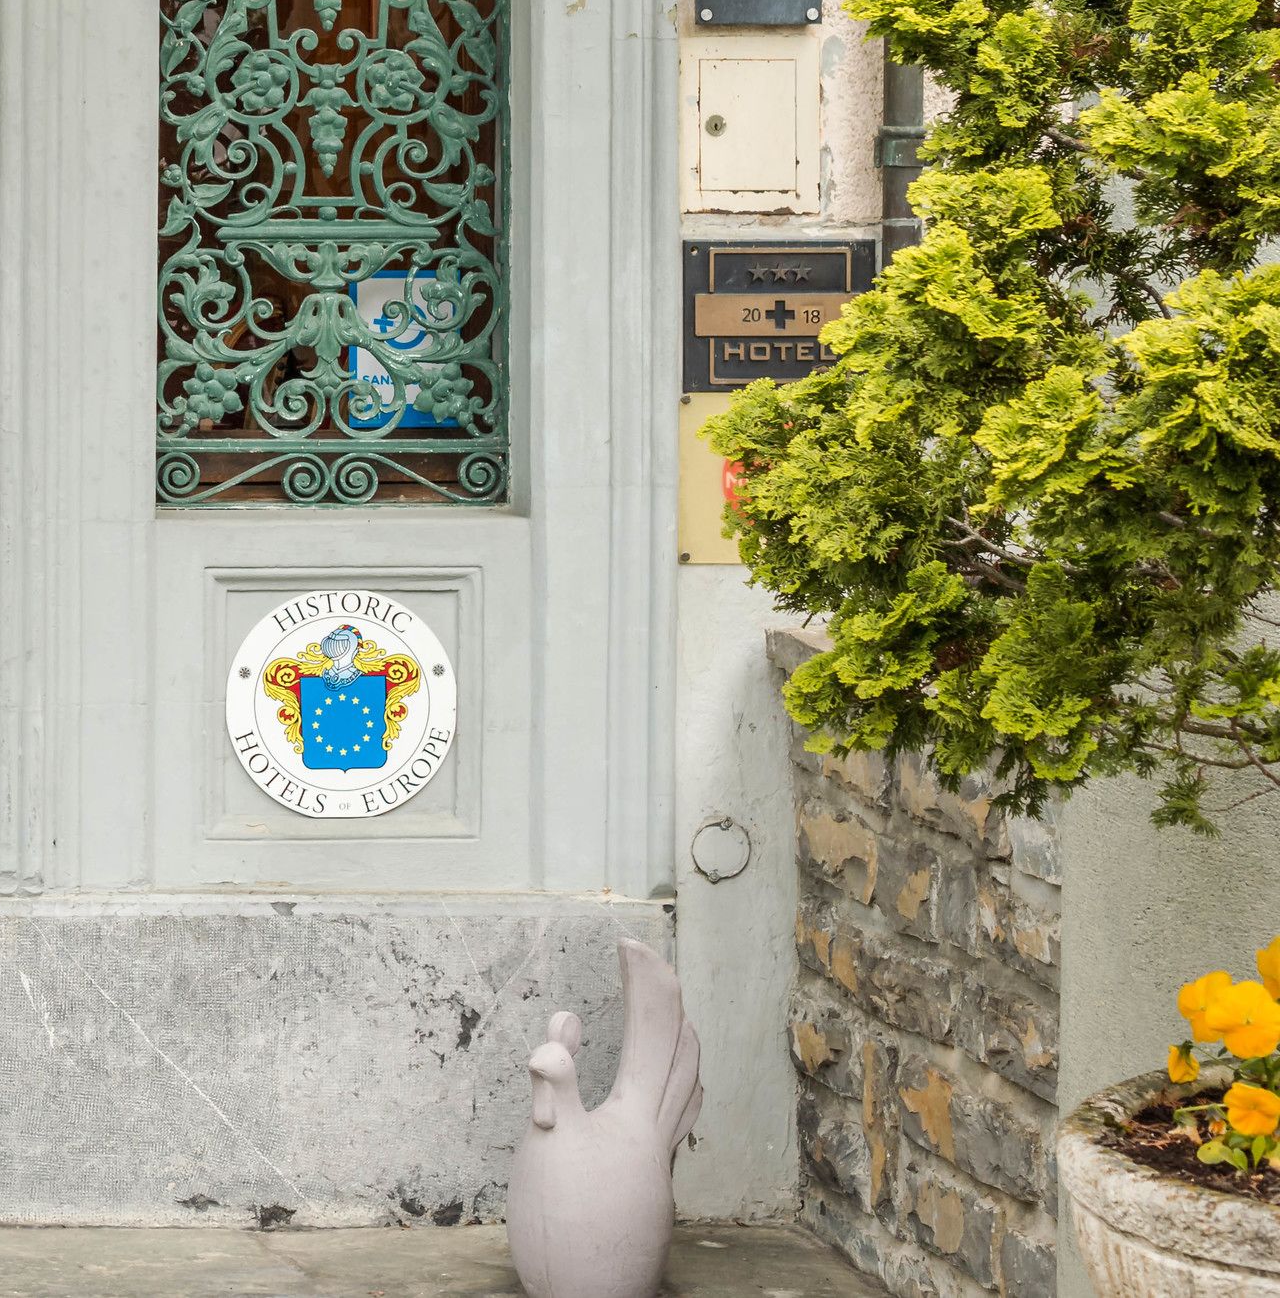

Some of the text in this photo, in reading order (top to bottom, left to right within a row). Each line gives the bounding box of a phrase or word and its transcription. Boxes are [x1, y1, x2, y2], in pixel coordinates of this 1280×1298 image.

[742, 308, 821, 324] 20 18
[724, 342, 837, 361] HOTEL
[271, 592, 413, 634] HISTORIC
[234, 727, 451, 814] HOTELS OF EUROPE
